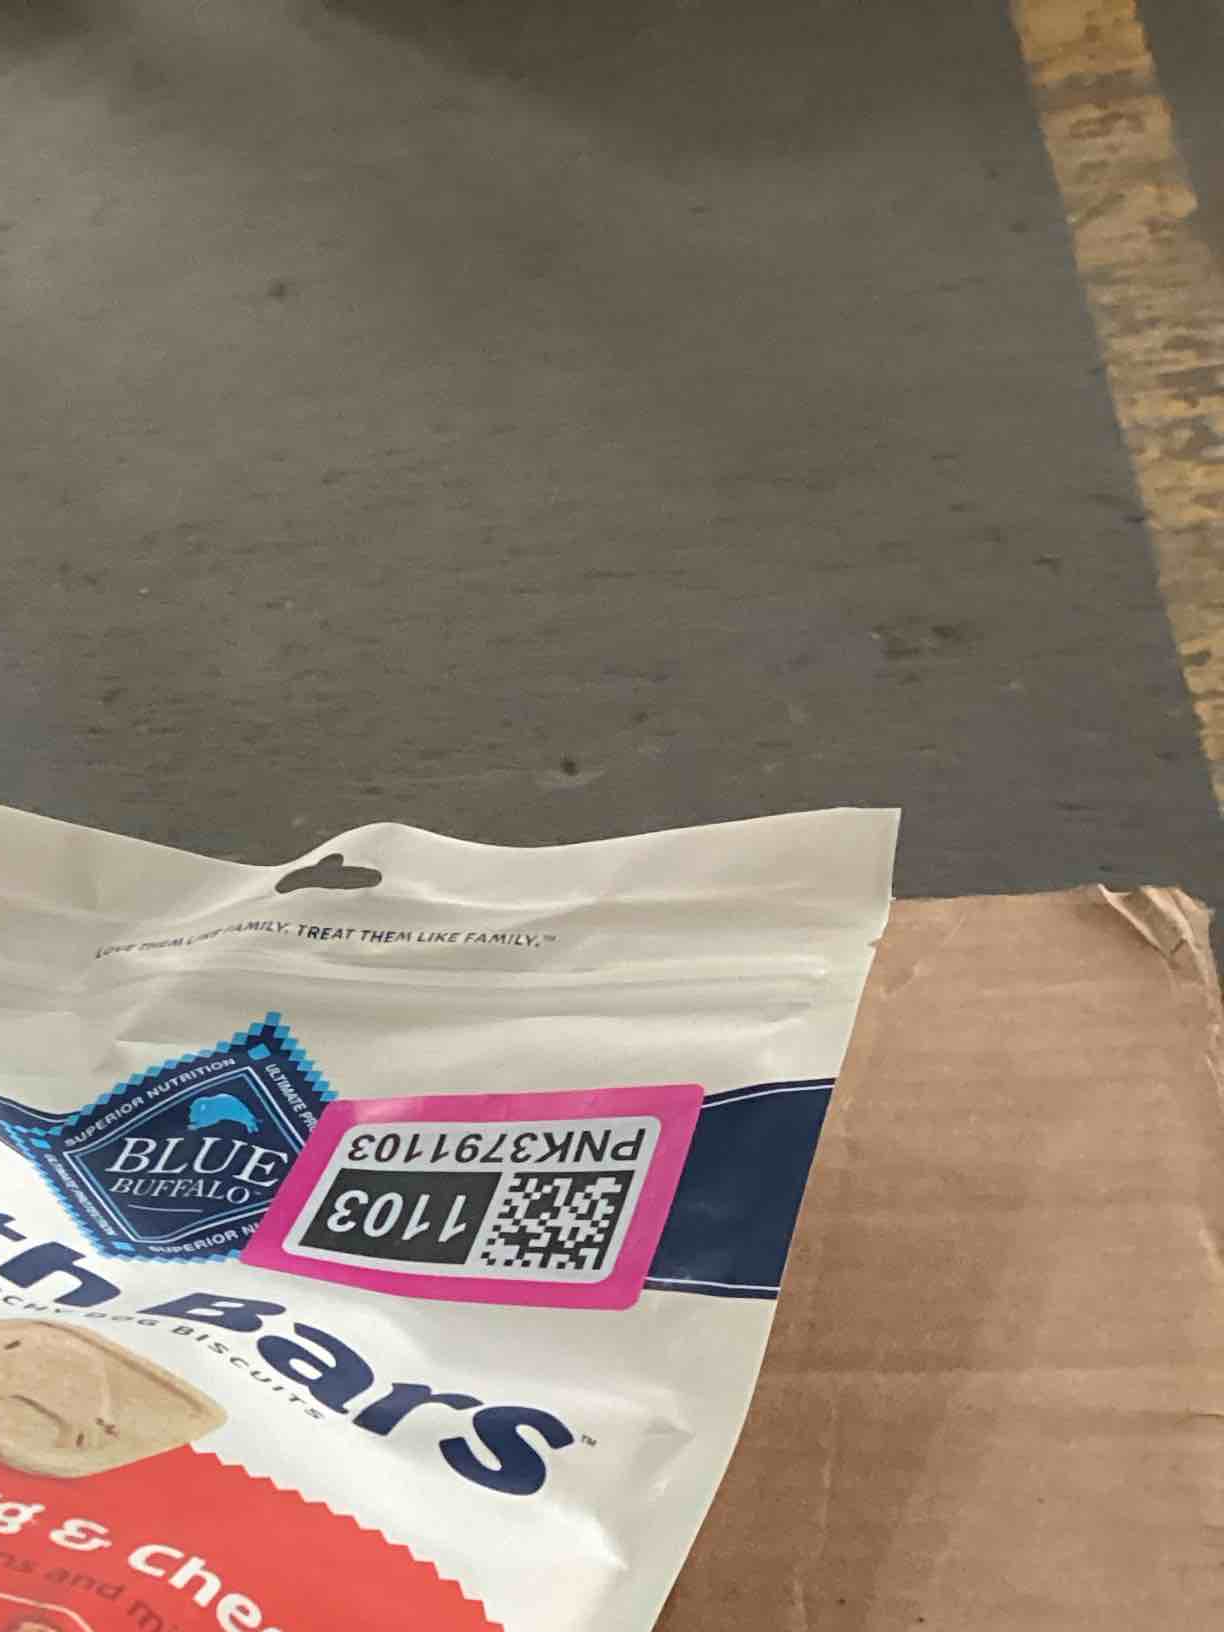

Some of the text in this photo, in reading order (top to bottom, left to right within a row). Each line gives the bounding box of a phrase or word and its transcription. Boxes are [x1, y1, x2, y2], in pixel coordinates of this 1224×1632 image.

[296, 923, 356, 941] TREAT
[359, 928, 413, 944] THEM
[417, 931, 459, 944] LIKE
[64, 1057, 237, 1147] SUPERIOR NUTRITION
[264, 1063, 307, 1117] ULTIMATE
[105, 1135, 289, 1188] BLUE
[347, 1128, 647, 1164] PNK3791103
[109, 1177, 251, 1205] BUFFALO
[326, 1189, 467, 1244] 1103
[82, 1311, 162, 1327] DOG
[170, 1324, 326, 1421] BISCUITS
[136, 1292, 575, 1497] Bars
[48, 1518, 113, 1552] &
[42, 1565, 129, 1602] and
